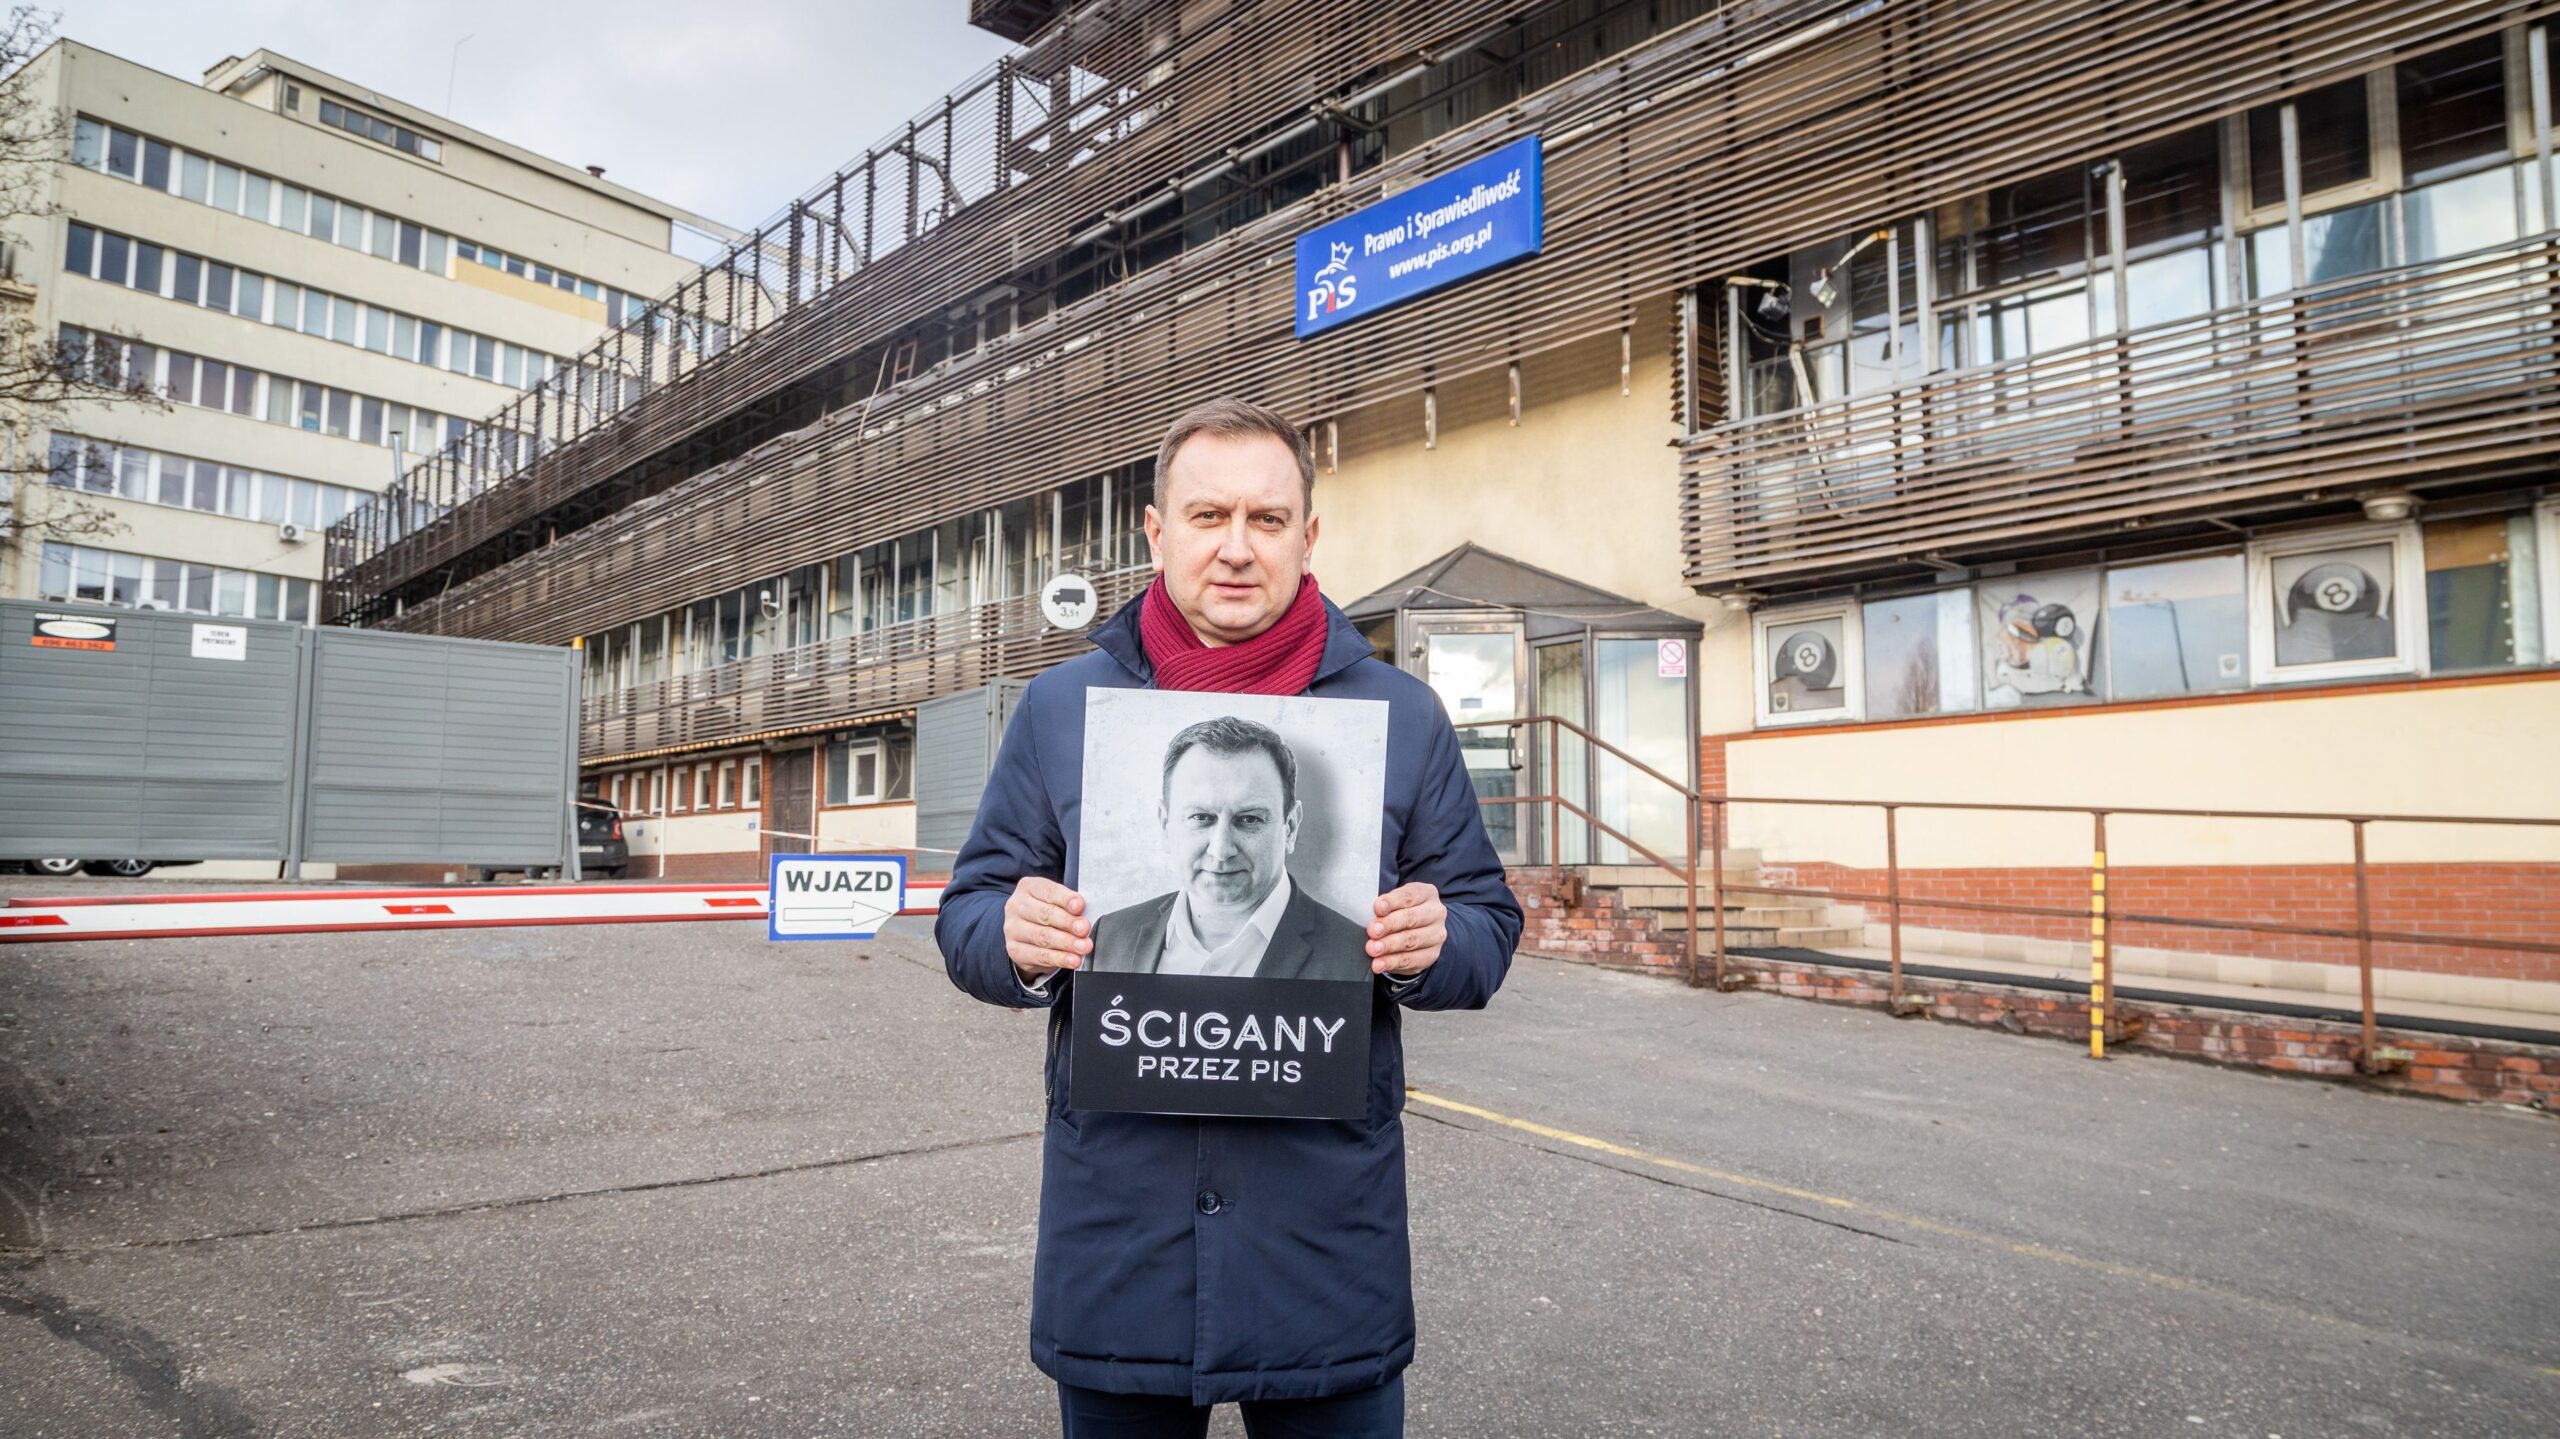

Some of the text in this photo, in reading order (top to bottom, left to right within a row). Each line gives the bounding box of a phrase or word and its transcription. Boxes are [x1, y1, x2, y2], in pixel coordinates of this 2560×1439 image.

[1364, 168, 1521, 256] Prawo i Sprawiedliwość
[1389, 221, 1493, 279] www.pis.org.pl
[2323, 582, 2351, 606] 8
[1799, 647, 1817, 668] 8
[785, 870, 893, 892] WJAZD
[1099, 994, 1346, 1053] ŚCIGANY
[1137, 1055, 1302, 1084] PRZEZ PIS
